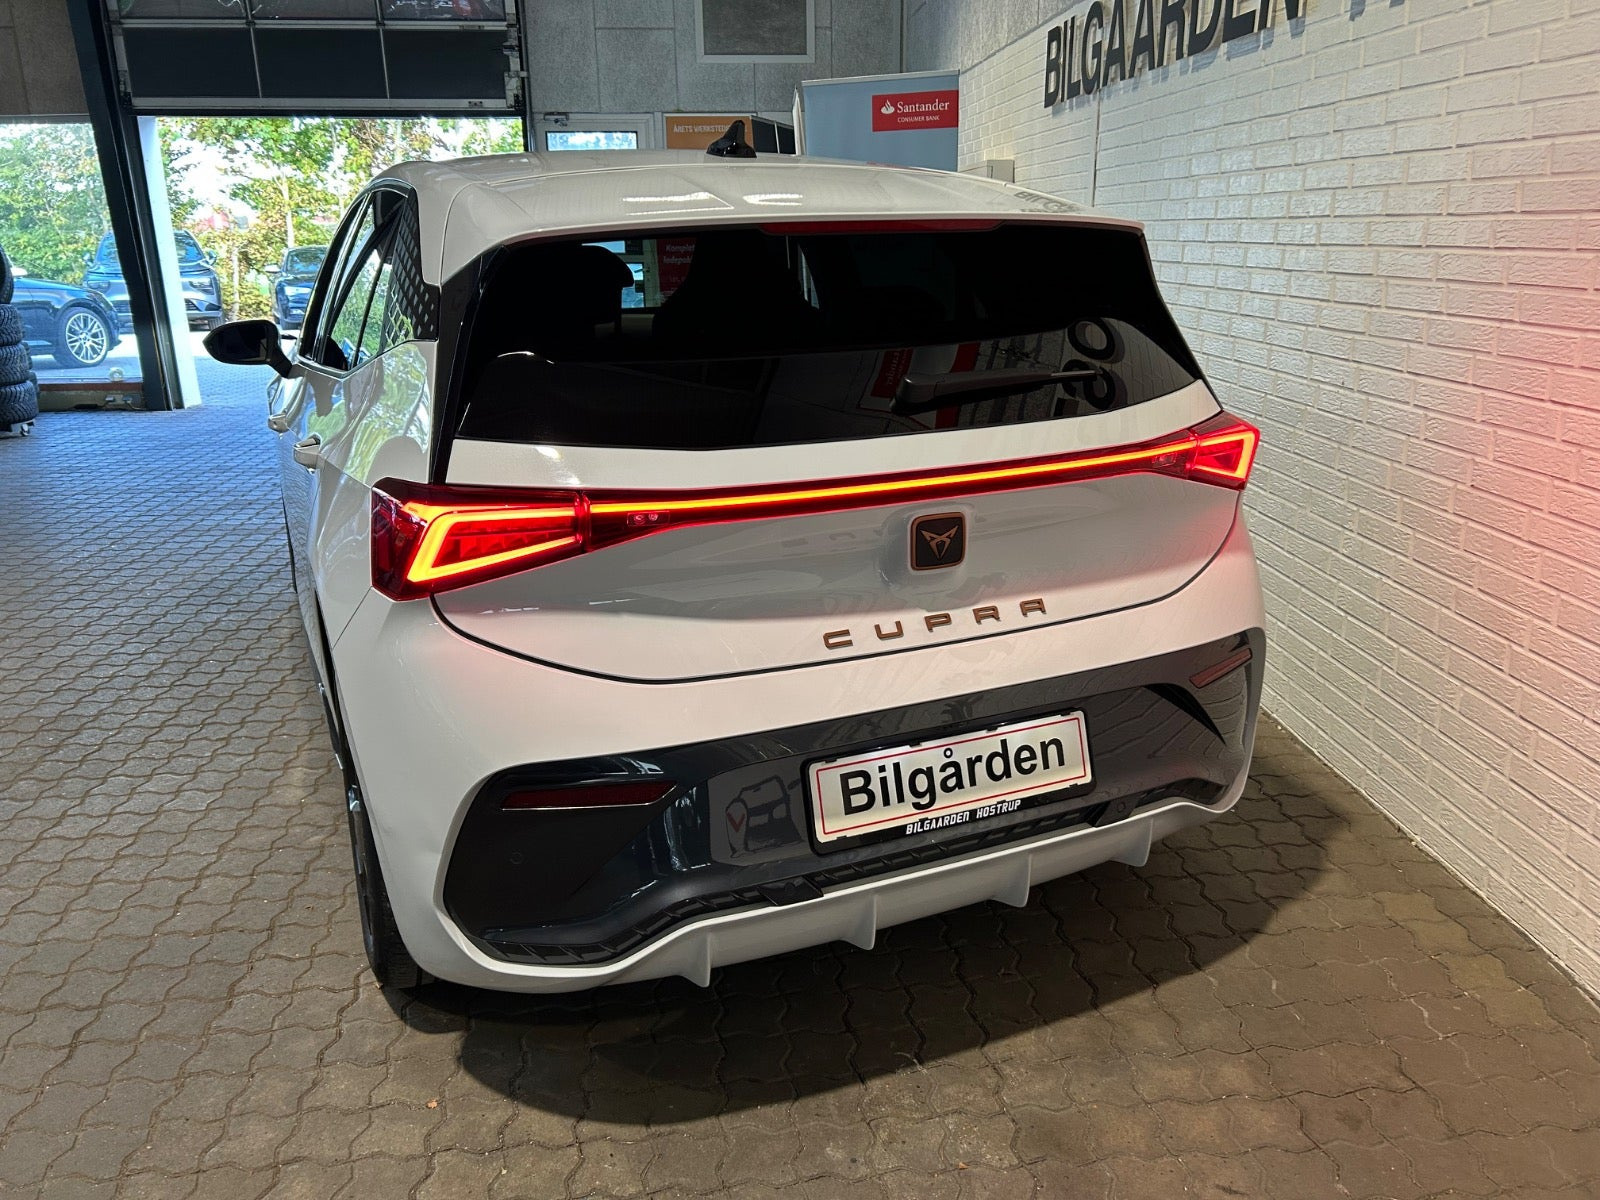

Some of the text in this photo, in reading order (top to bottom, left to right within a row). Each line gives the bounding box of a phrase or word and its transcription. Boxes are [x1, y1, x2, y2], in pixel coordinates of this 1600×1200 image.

[1043, 0, 1303, 109] BILGAAR
[897, 98, 950, 113] Santander
[897, 115, 925, 123] CONSUMER
[823, 598, 1047, 649] CUPRA
[839, 737, 1065, 811] Bilgården
[905, 799, 1021, 835] BILGAARDEN HOSTRUP
